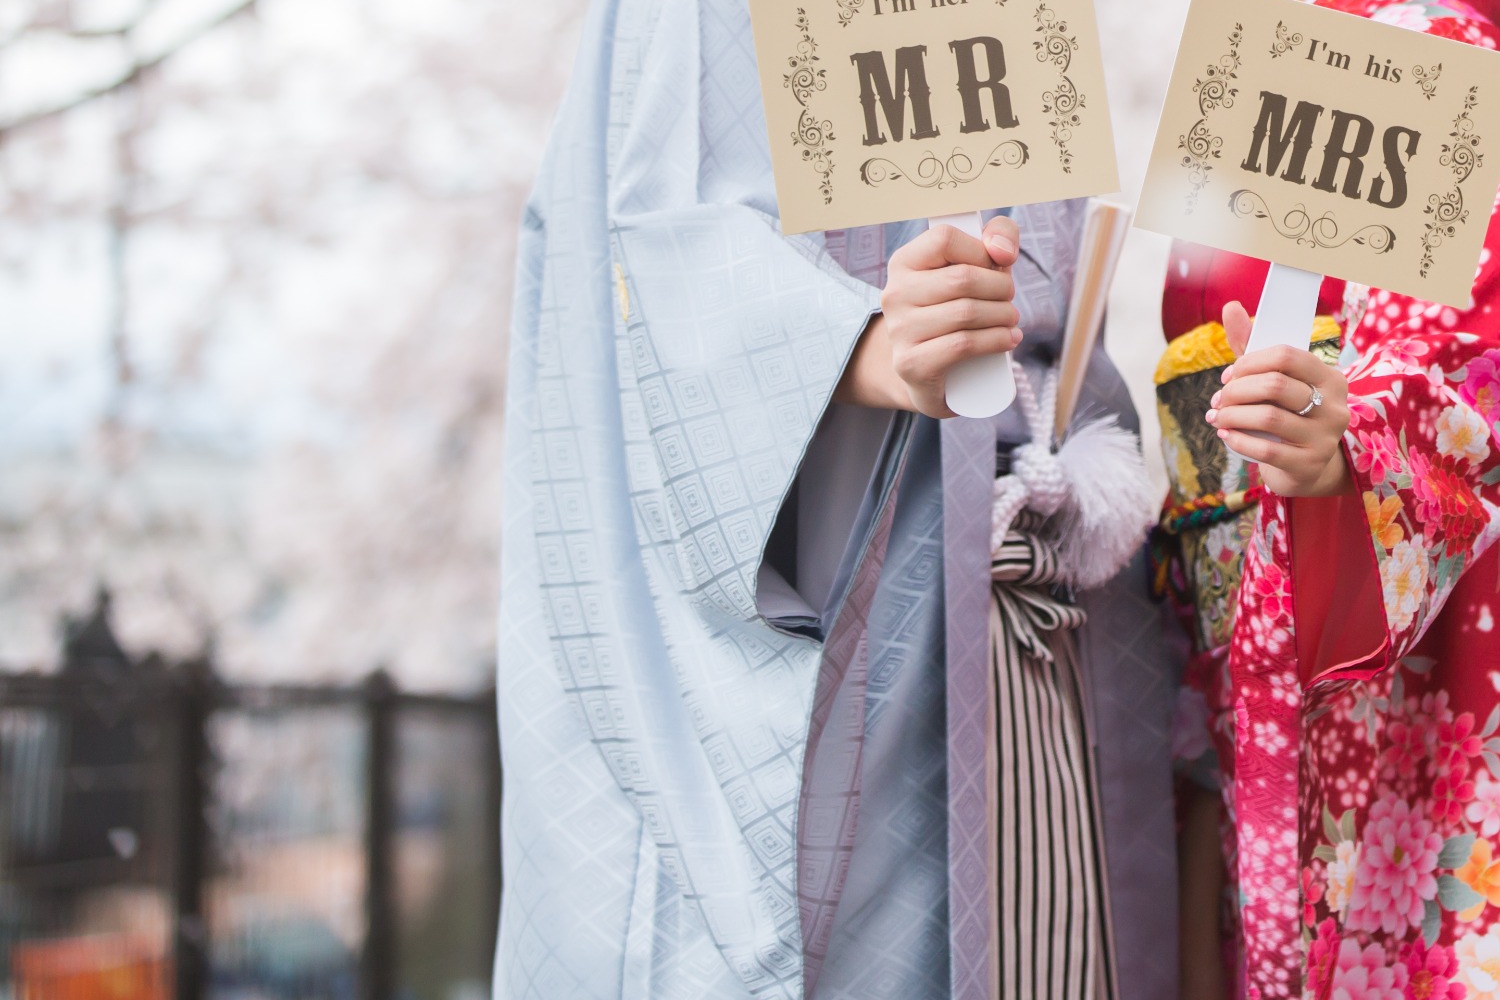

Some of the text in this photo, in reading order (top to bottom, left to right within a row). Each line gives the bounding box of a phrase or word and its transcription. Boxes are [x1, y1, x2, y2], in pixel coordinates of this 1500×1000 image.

[1305, 37, 1403, 84] I'm his
[1239, 90, 1422, 209] MRS
